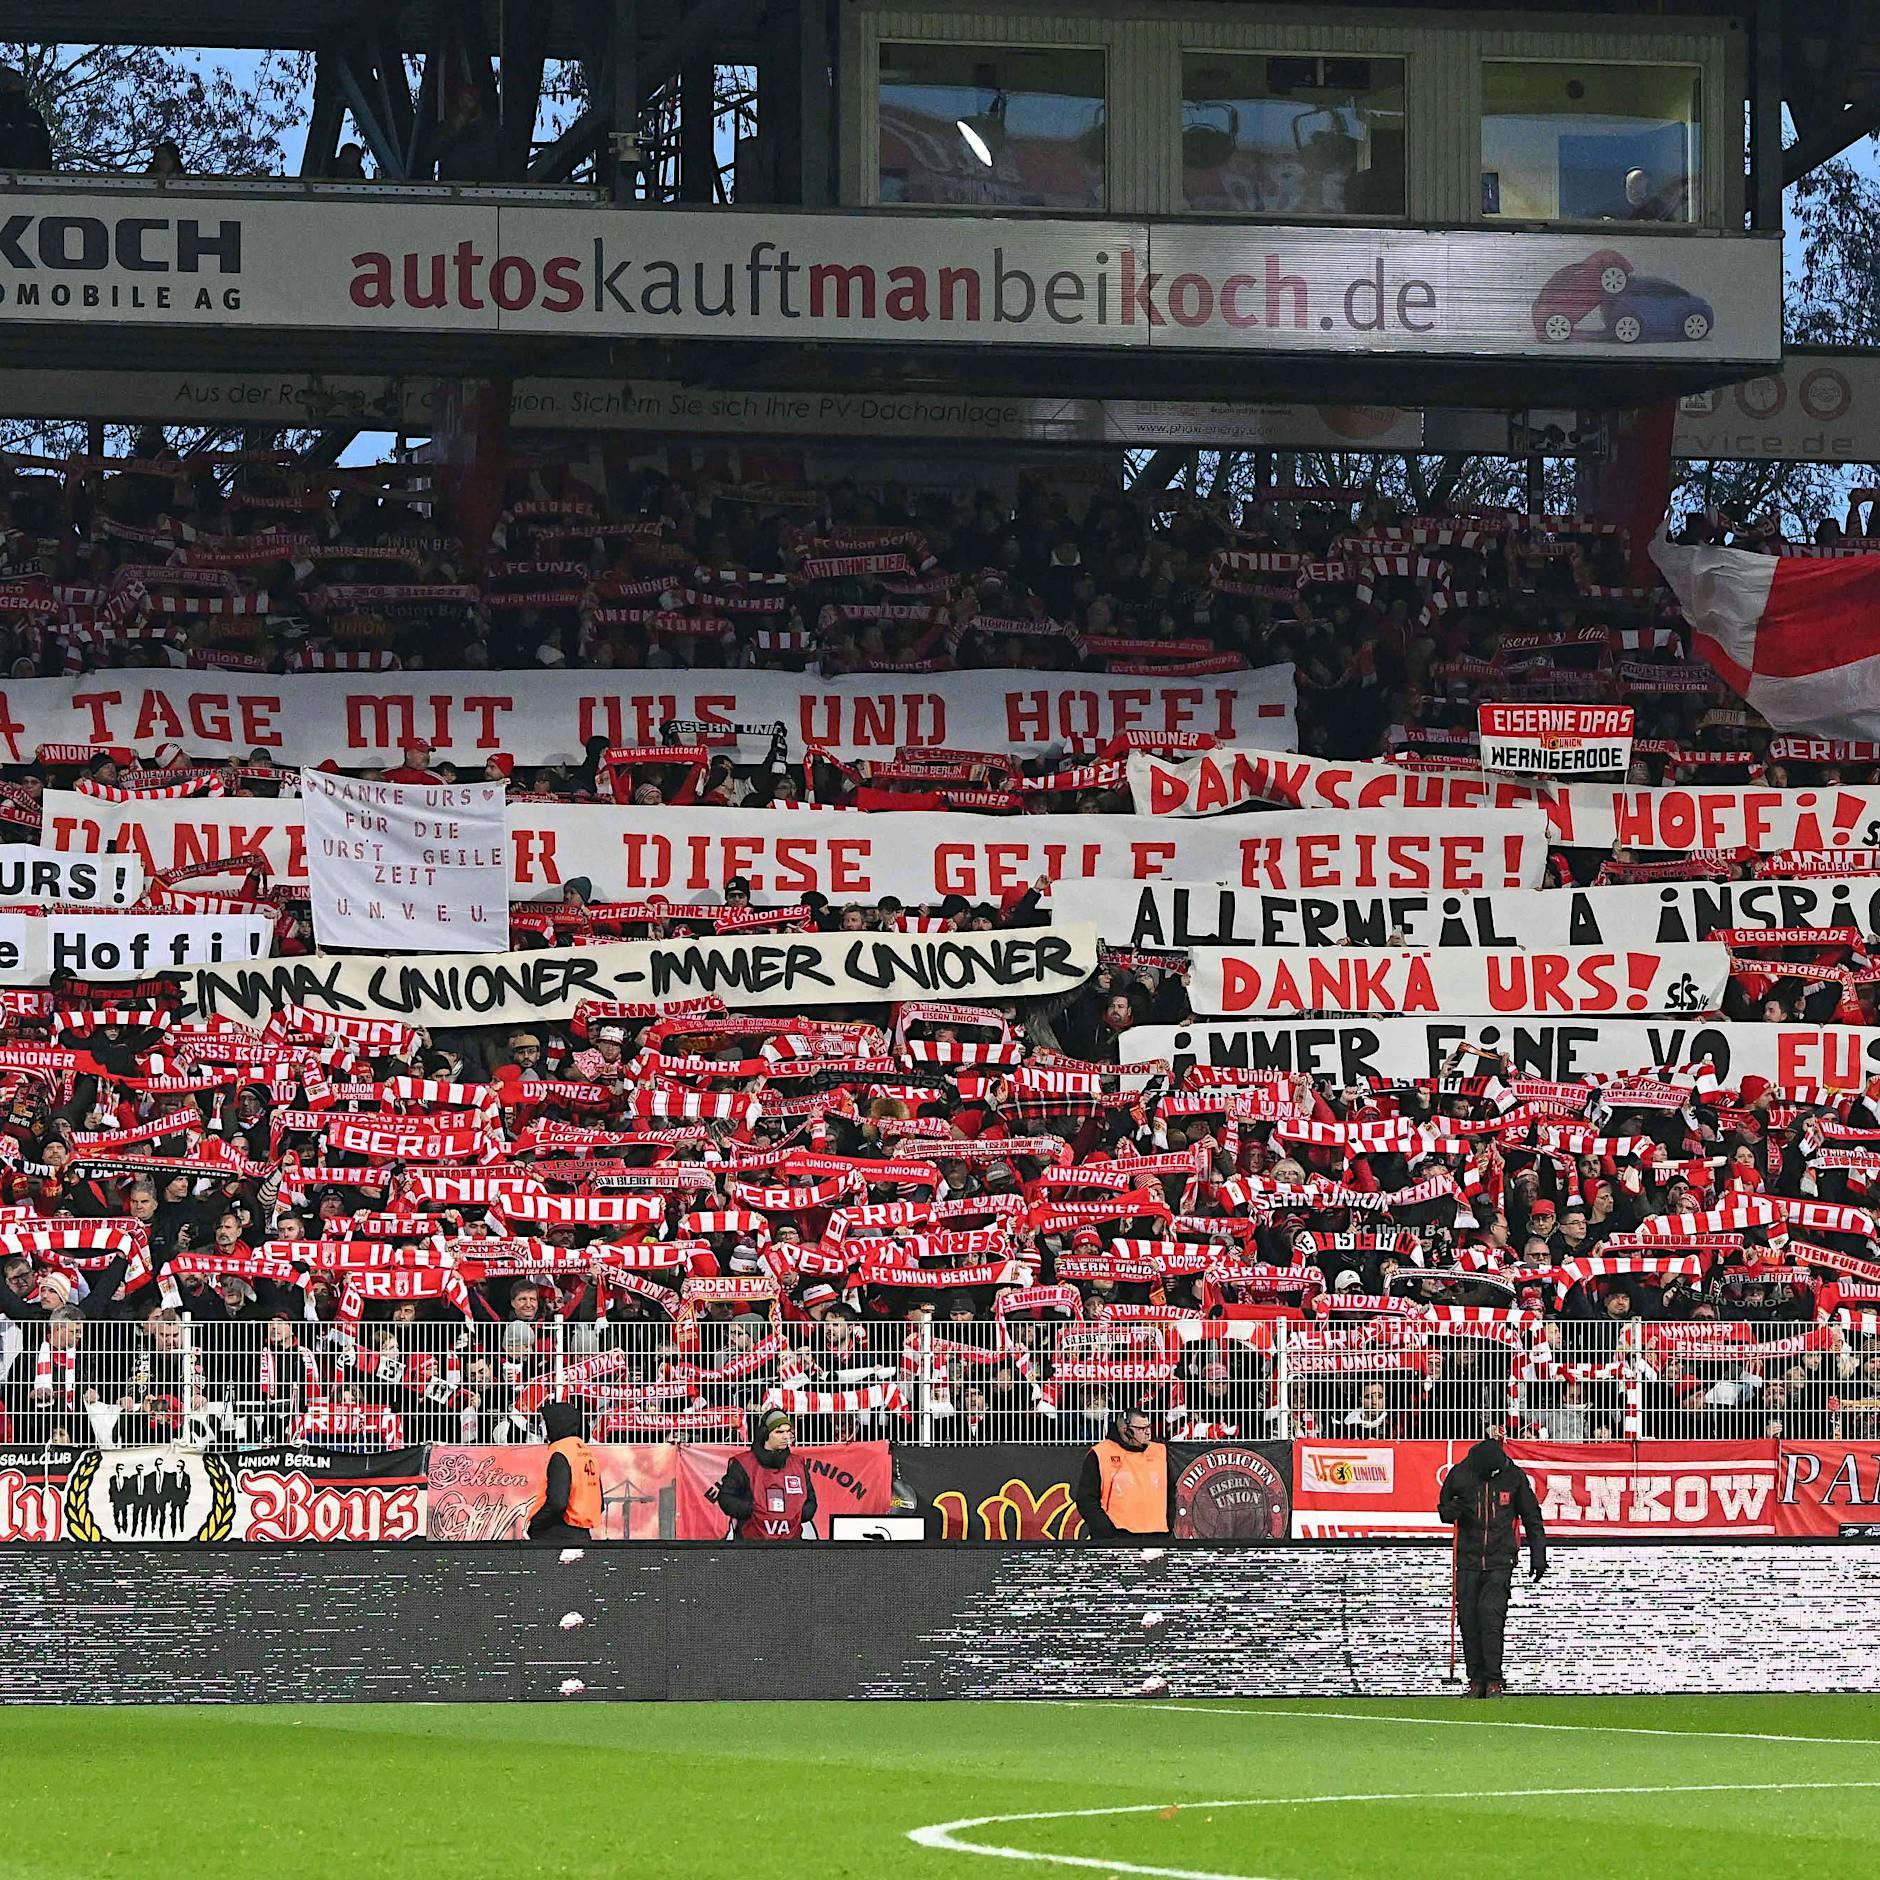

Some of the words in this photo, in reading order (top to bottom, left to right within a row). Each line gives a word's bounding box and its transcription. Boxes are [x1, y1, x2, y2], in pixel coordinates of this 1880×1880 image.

[349, 236, 1436, 332] autoskauftmanbeikoch.de
[0, 284, 170, 308] MOBILE
[195, 288, 241, 310] AG
[174, 383, 221, 405] Aus
[228, 382, 273, 406] der
[668, 392, 703, 415] Sie
[711, 393, 758, 417] sich
[766, 396, 811, 419] Ihre
[72, 688, 284, 747] TAGE
[345, 695, 513, 749] MIT
[799, 694, 947, 748] UND
[1493, 710, 1576, 732] EISERNE
[1580, 710, 1633, 737] OPAS
[1126, 731, 1199, 747] UNIONER
[1491, 746, 1625, 774] WERNIGERODE
[323, 778, 405, 806] DANKE
[425, 788, 473, 808] URS
[345, 809, 390, 833] FÜR
[414, 820, 461, 840] DIE
[1612, 791, 1868, 850] HOFFi!
[422, 847, 503, 867] GEILE
[622, 833, 872, 893] DIESE
[1239, 835, 1525, 890] REISE!
[374, 865, 438, 887] ZEIT
[1569, 891, 1604, 947] A
[1734, 930, 1850, 948] GEGENGERADE
[369, 956, 616, 1012] UNIONER
[649, 945, 836, 995] IMMER
[845, 936, 1086, 991] UNIONER
[1220, 952, 1440, 1013] DANKÄ
[1487, 951, 1662, 1013] URS!
[659, 1055, 741, 1074] UNIONER
[1106, 1062, 1151, 1077] UNION
[1238, 1067, 1284, 1084] Union
[148, 1075, 223, 1092] UNIONER
[1515, 1083, 1557, 1099] UNION
[72, 1130, 96, 1144] NUR
[885, 1168, 931, 1184] UNIONER
[1047, 1167, 1128, 1189] UNIONER
[178, 1254, 293, 1279] UNIONER
[872, 1271, 889, 1287] FC
[891, 1272, 937, 1289] UNION
[940, 1269, 994, 1288] BERLIN
[1014, 1295, 1058, 1310] UNION
[238, 1453, 281, 1468] UNION
[285, 1454, 332, 1469] BERLIN
[1183, 1463, 1206, 1490] DIE
[1206, 1452, 1276, 1487] ÜBLICHEN
[806, 1459, 868, 1500] NION
[1353, 1465, 1388, 1482] UNION
[1209, 1477, 1251, 1497] EISERN
[1534, 1473, 1776, 1522] ANKOW
[245, 1472, 423, 1541] Boys
[1215, 1490, 1262, 1508] UNION
[763, 1519, 791, 1535] VA
